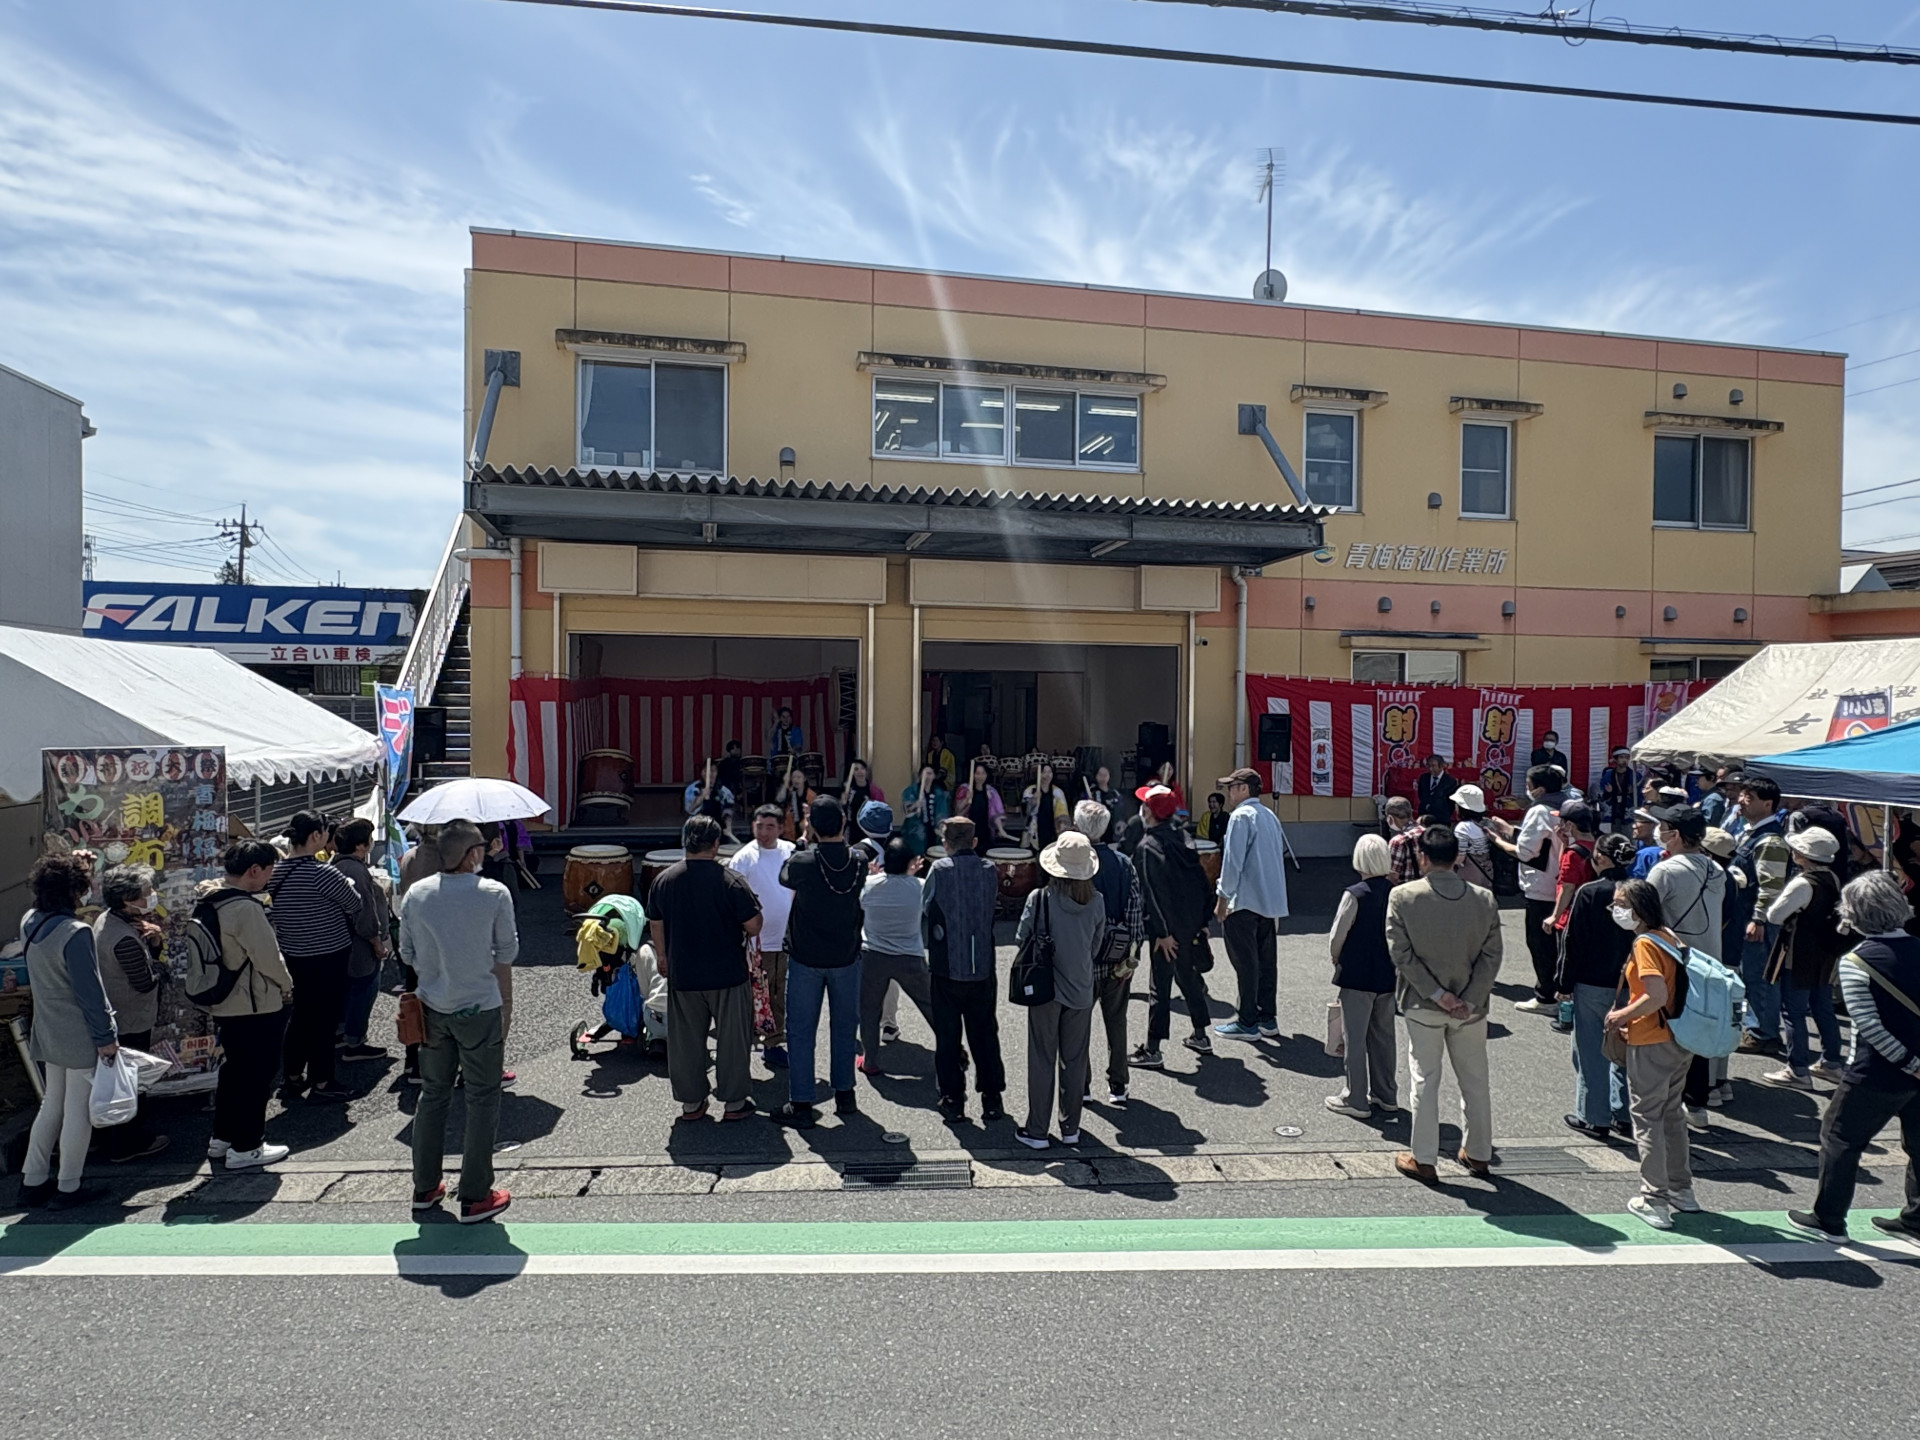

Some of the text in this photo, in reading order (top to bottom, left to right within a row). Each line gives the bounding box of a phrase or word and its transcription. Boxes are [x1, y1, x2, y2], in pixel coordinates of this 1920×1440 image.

[1346, 543, 1508, 574] 青梅福祉作業所
[82, 593, 415, 637] FALKEN
[270, 646, 372, 663] 立合い車検
